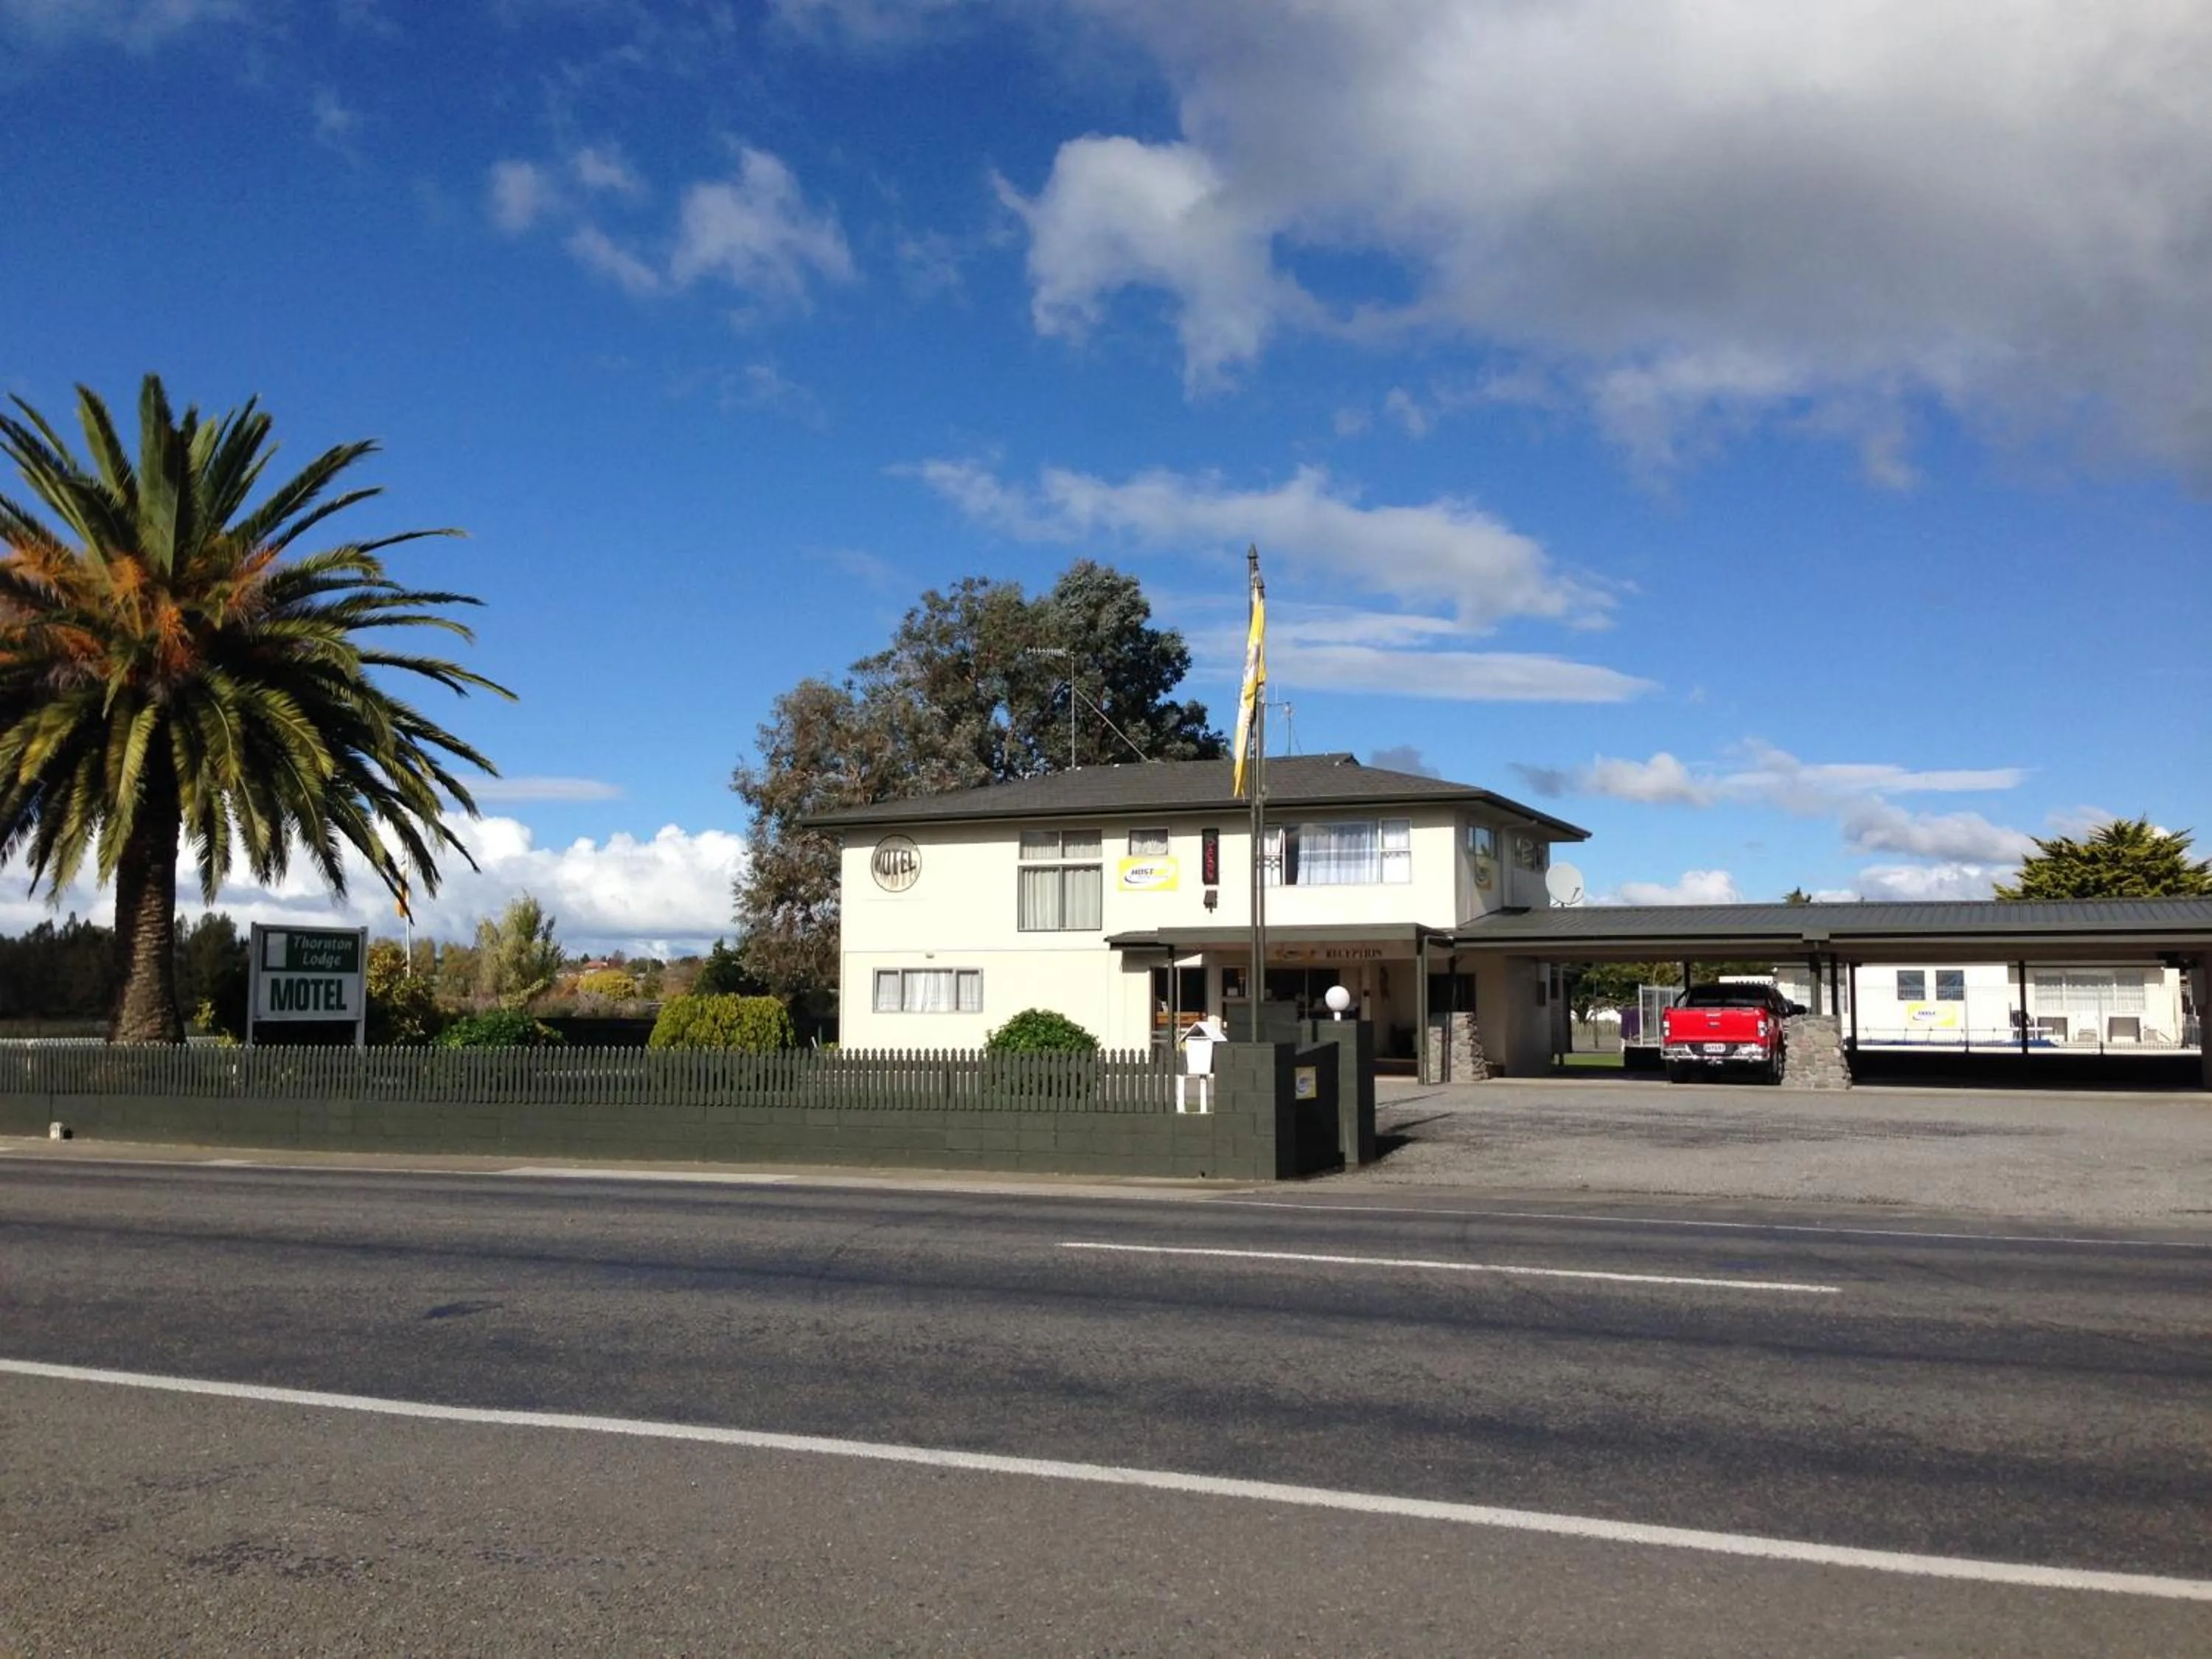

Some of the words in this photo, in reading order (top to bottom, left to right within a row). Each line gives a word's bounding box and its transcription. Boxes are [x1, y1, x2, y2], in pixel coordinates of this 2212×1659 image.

[874, 849, 916, 876] MOTEL
[293, 934, 353, 950] Thornton
[302, 952, 342, 968] Lodge
[1326, 948, 1383, 959] RECEPTION
[270, 978, 347, 1011] MOTEL
